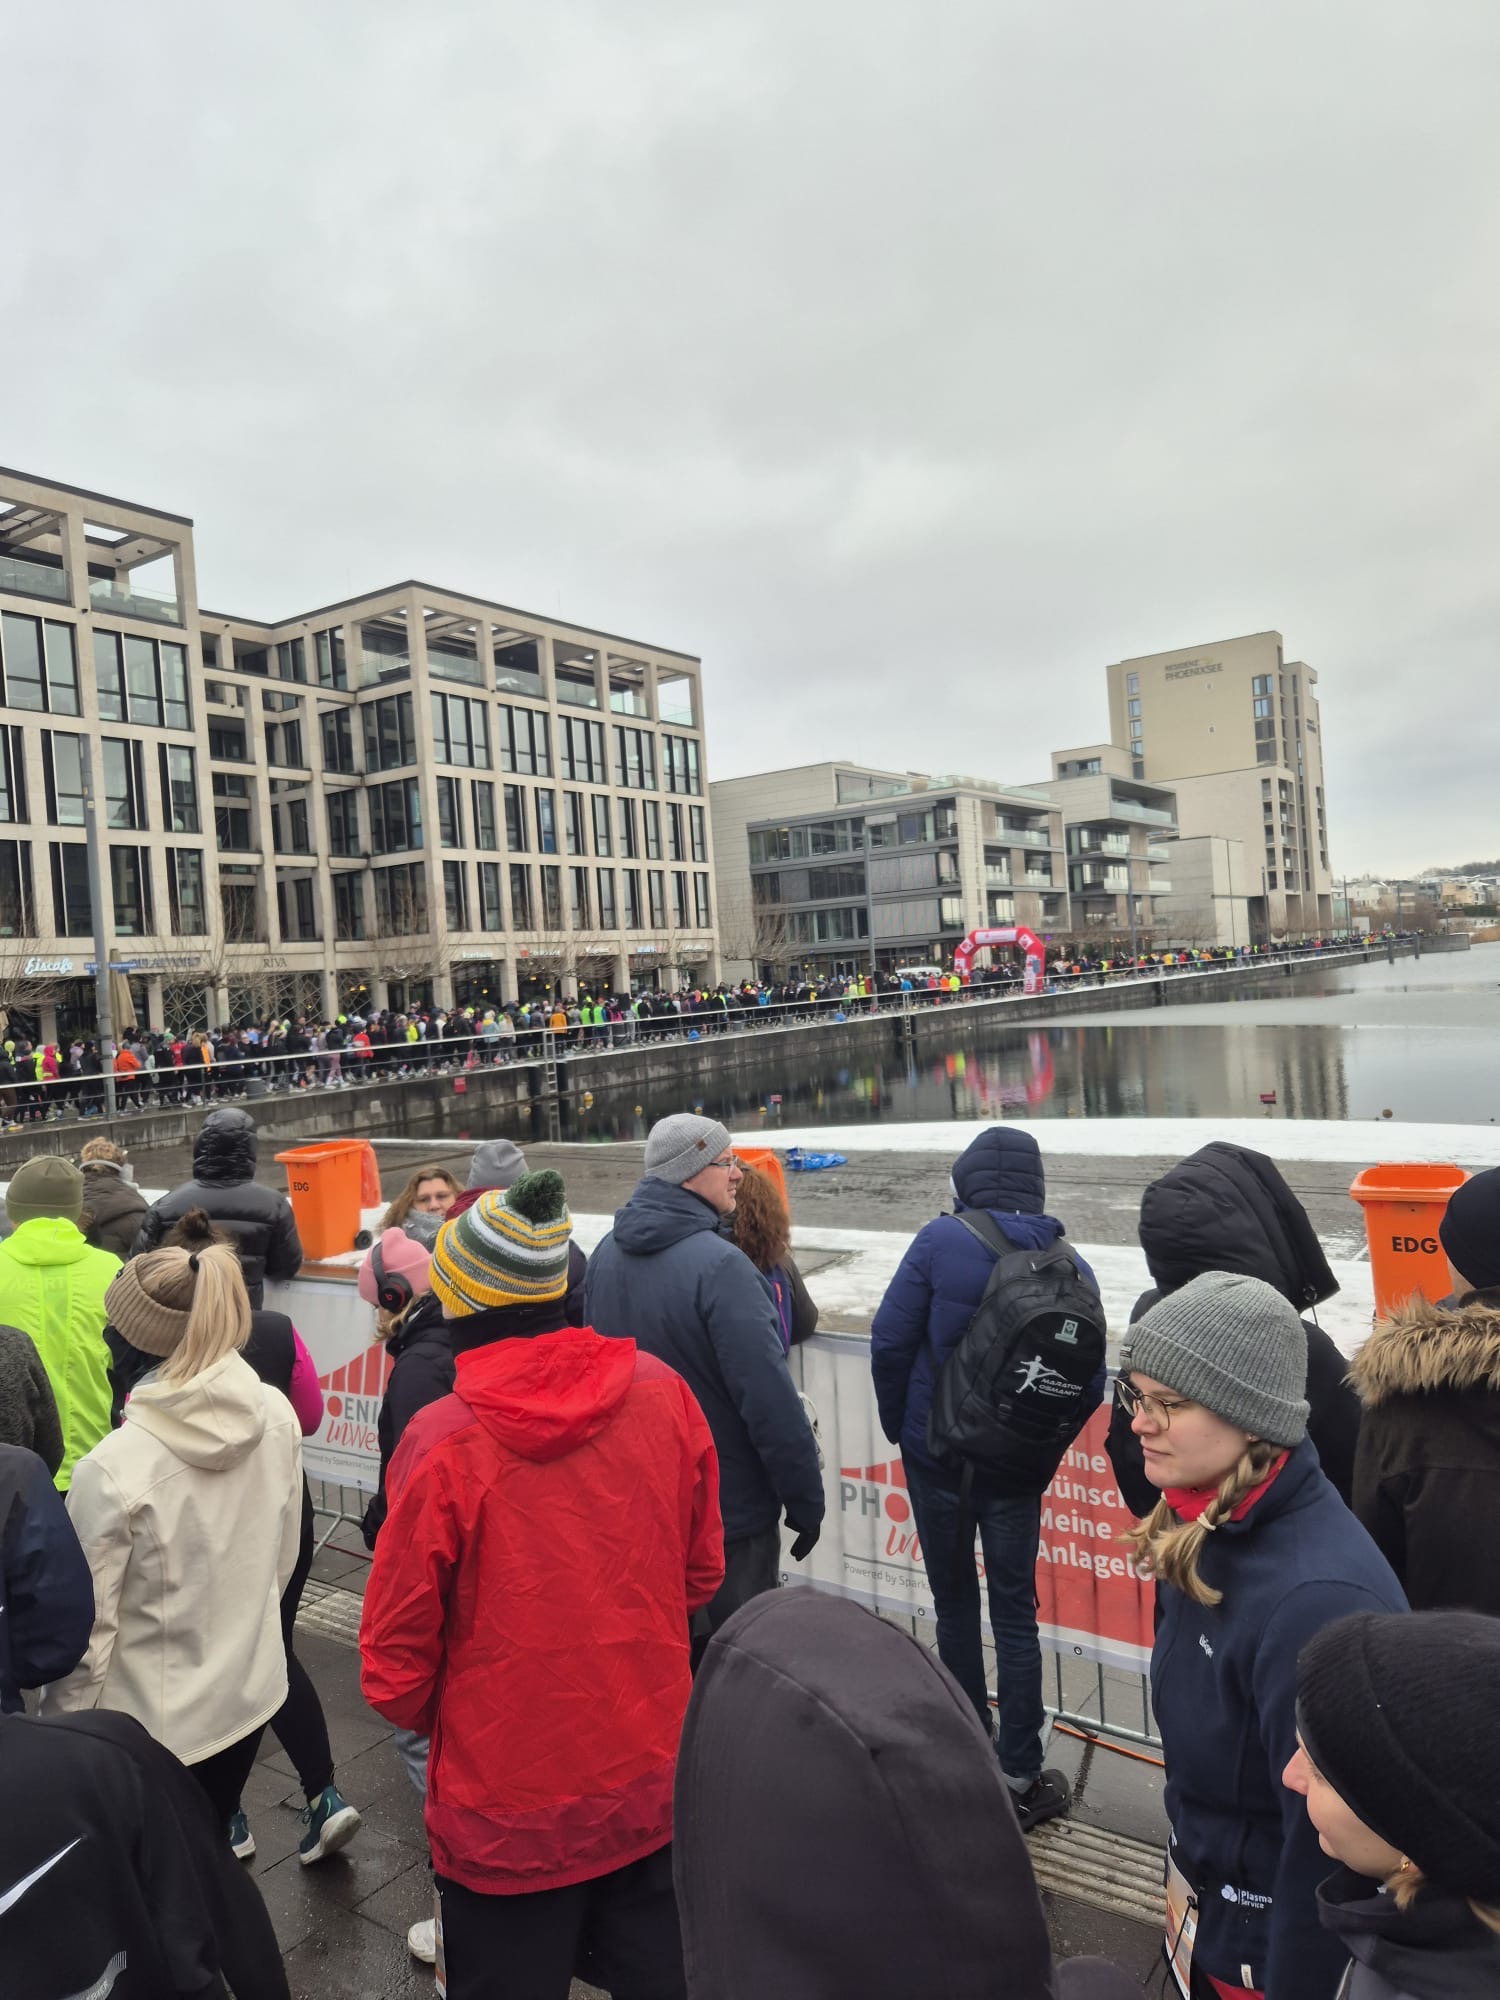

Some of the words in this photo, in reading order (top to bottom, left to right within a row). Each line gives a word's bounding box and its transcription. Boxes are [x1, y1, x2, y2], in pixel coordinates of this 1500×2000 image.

[263, 957, 287, 968] RIVA
[293, 1181, 309, 1192] EDG
[1391, 1236, 1438, 1254] EDG
[1060, 1444, 1107, 1474] ine
[844, 1562, 883, 1580] Powered
[886, 1568, 896, 1585] by
[1241, 1890, 1273, 1904] Plasma
[1241, 1899, 1265, 1909] Service
